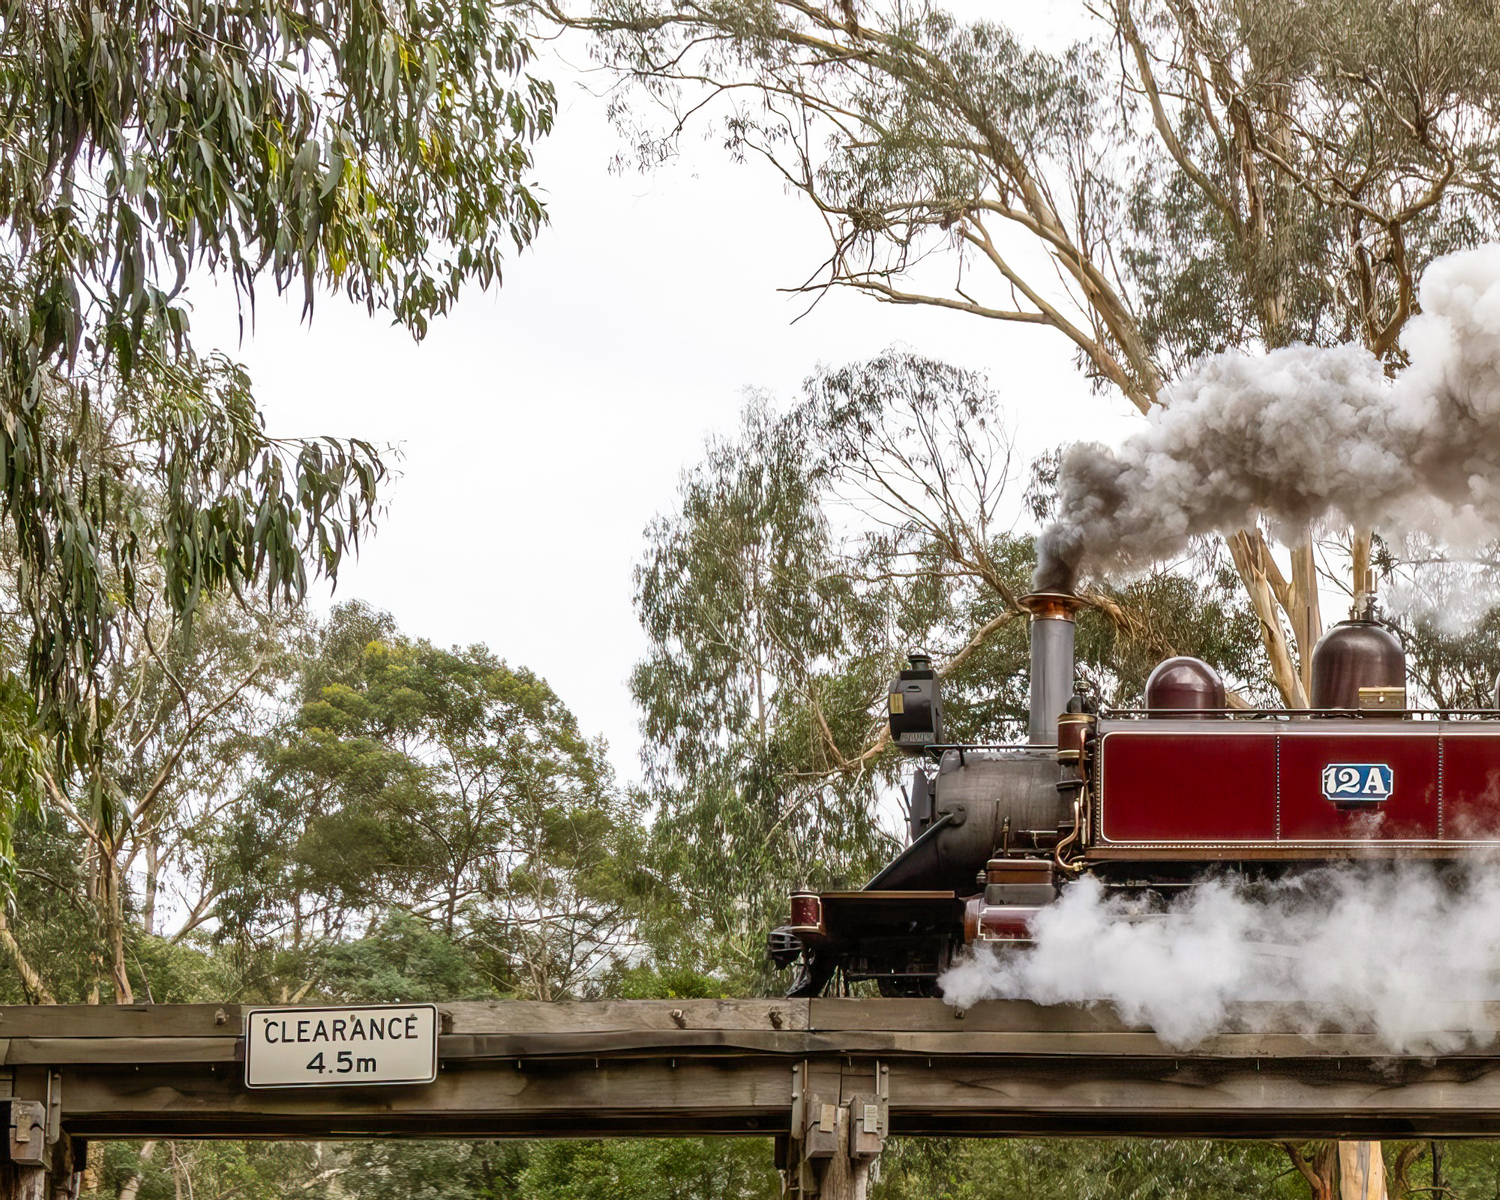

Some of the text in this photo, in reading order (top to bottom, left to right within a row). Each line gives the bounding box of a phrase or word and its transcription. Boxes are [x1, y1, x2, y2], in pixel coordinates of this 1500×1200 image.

[1324, 767, 1389, 794] 12A
[265, 1016, 419, 1044] CLEARANCE
[306, 1051, 377, 1074] 4.5m
